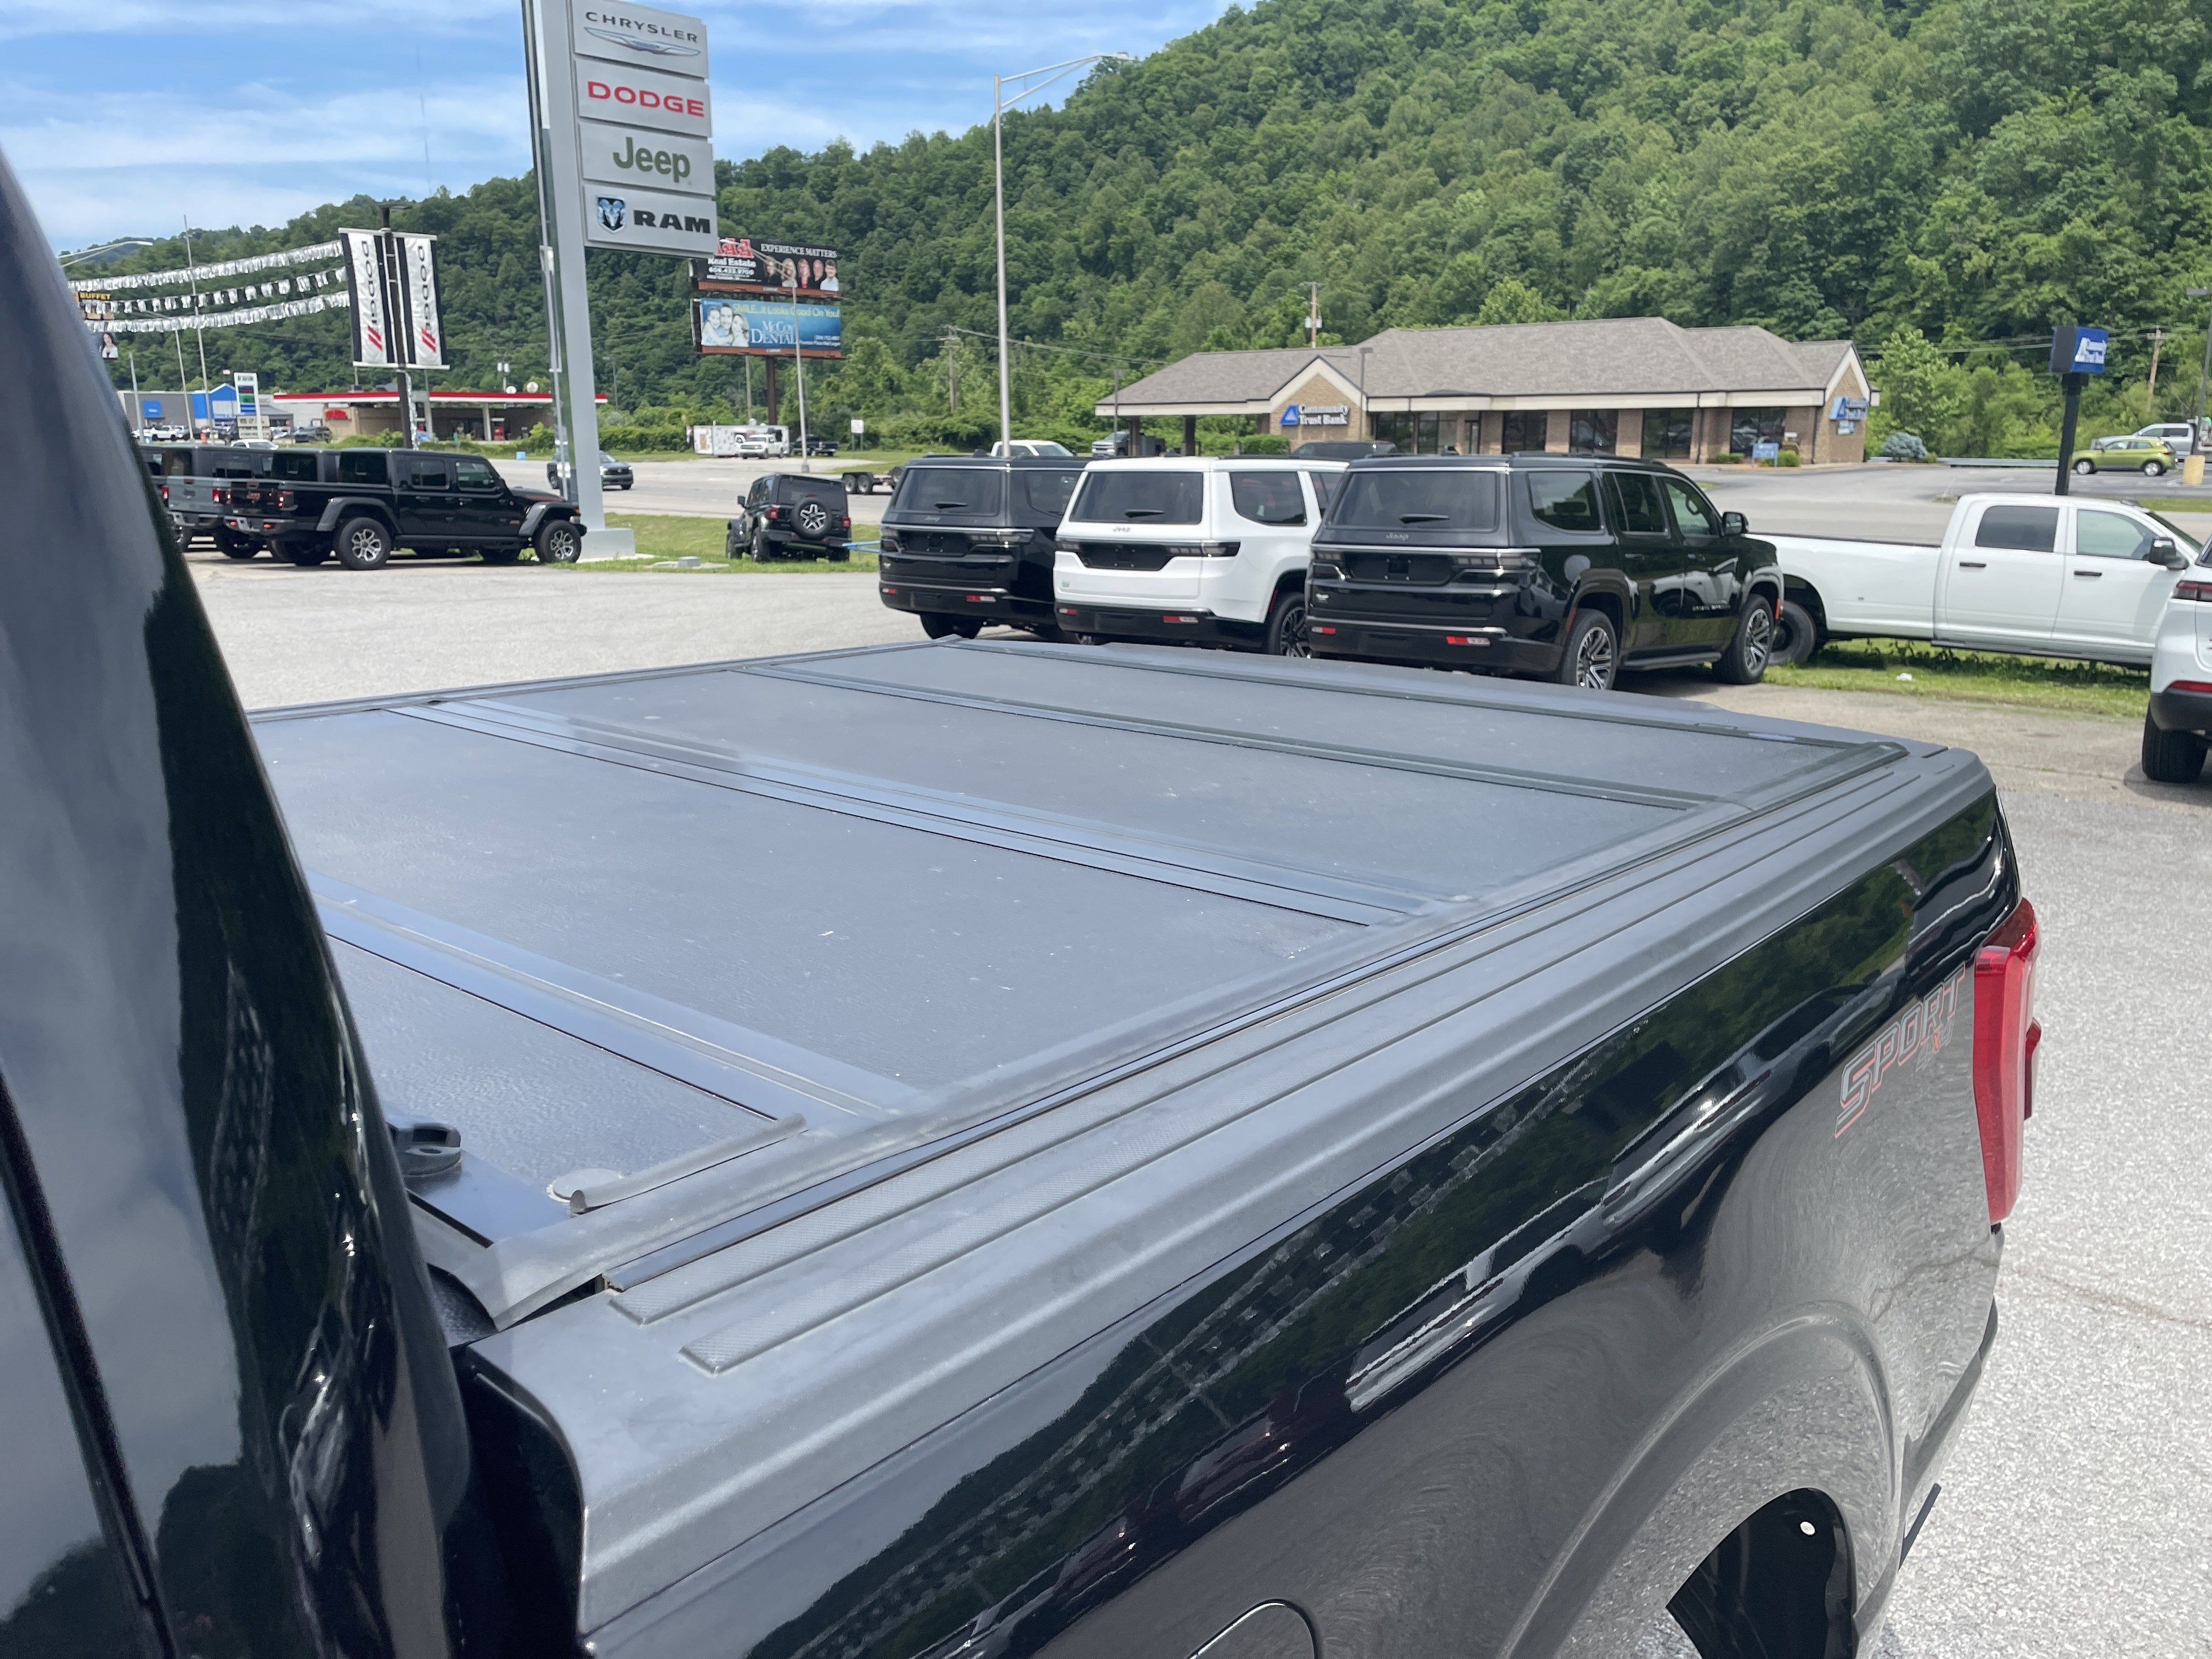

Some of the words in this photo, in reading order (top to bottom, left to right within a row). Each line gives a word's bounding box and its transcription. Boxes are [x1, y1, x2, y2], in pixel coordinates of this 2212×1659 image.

[585, 11, 698, 43] CHRYSLER
[588, 81, 704, 117] DODGE
[613, 136, 690, 183] Jeep
[633, 210, 710, 234] RAM
[761, 244, 805, 255] EXPERIENCE
[805, 248, 837, 258] MATTERS
[80, 292, 110, 300] BUFFET
[790, 307, 811, 316] Good
[812, 307, 823, 317] On
[824, 309, 840, 318] You!
[1298, 414, 1322, 425] Trust
[1323, 414, 1348, 425] Bank
[1835, 963, 1966, 1139] SPORT
